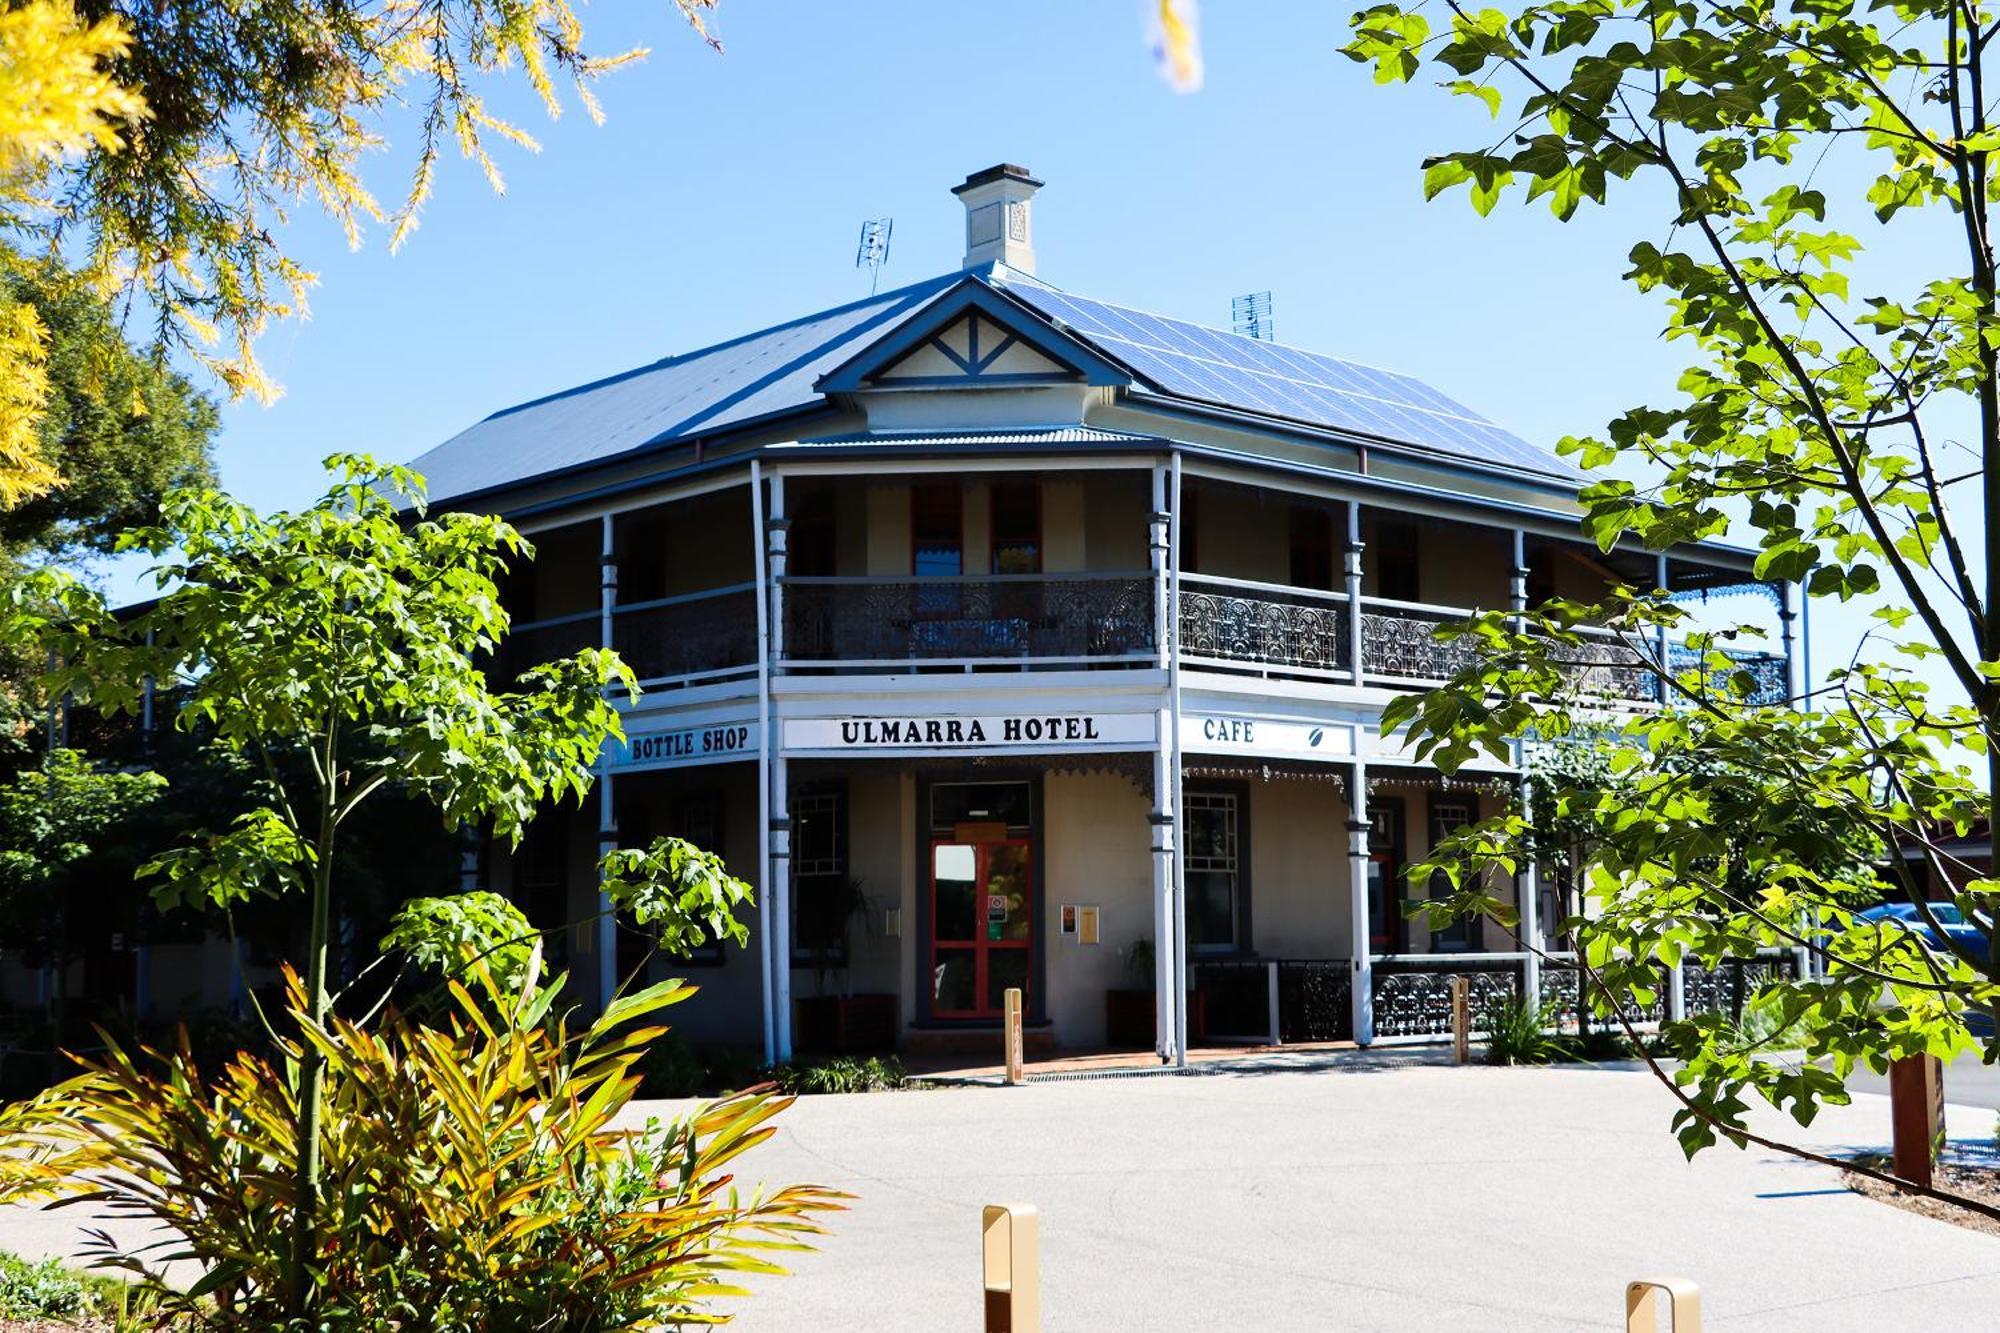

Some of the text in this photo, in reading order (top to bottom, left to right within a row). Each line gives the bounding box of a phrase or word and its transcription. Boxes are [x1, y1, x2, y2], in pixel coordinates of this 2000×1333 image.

[632, 727, 748, 759] BOTTLE SHOP
[841, 718, 1099, 744] ULMARRA HOTEL
[1204, 718, 1254, 743] CAFE
